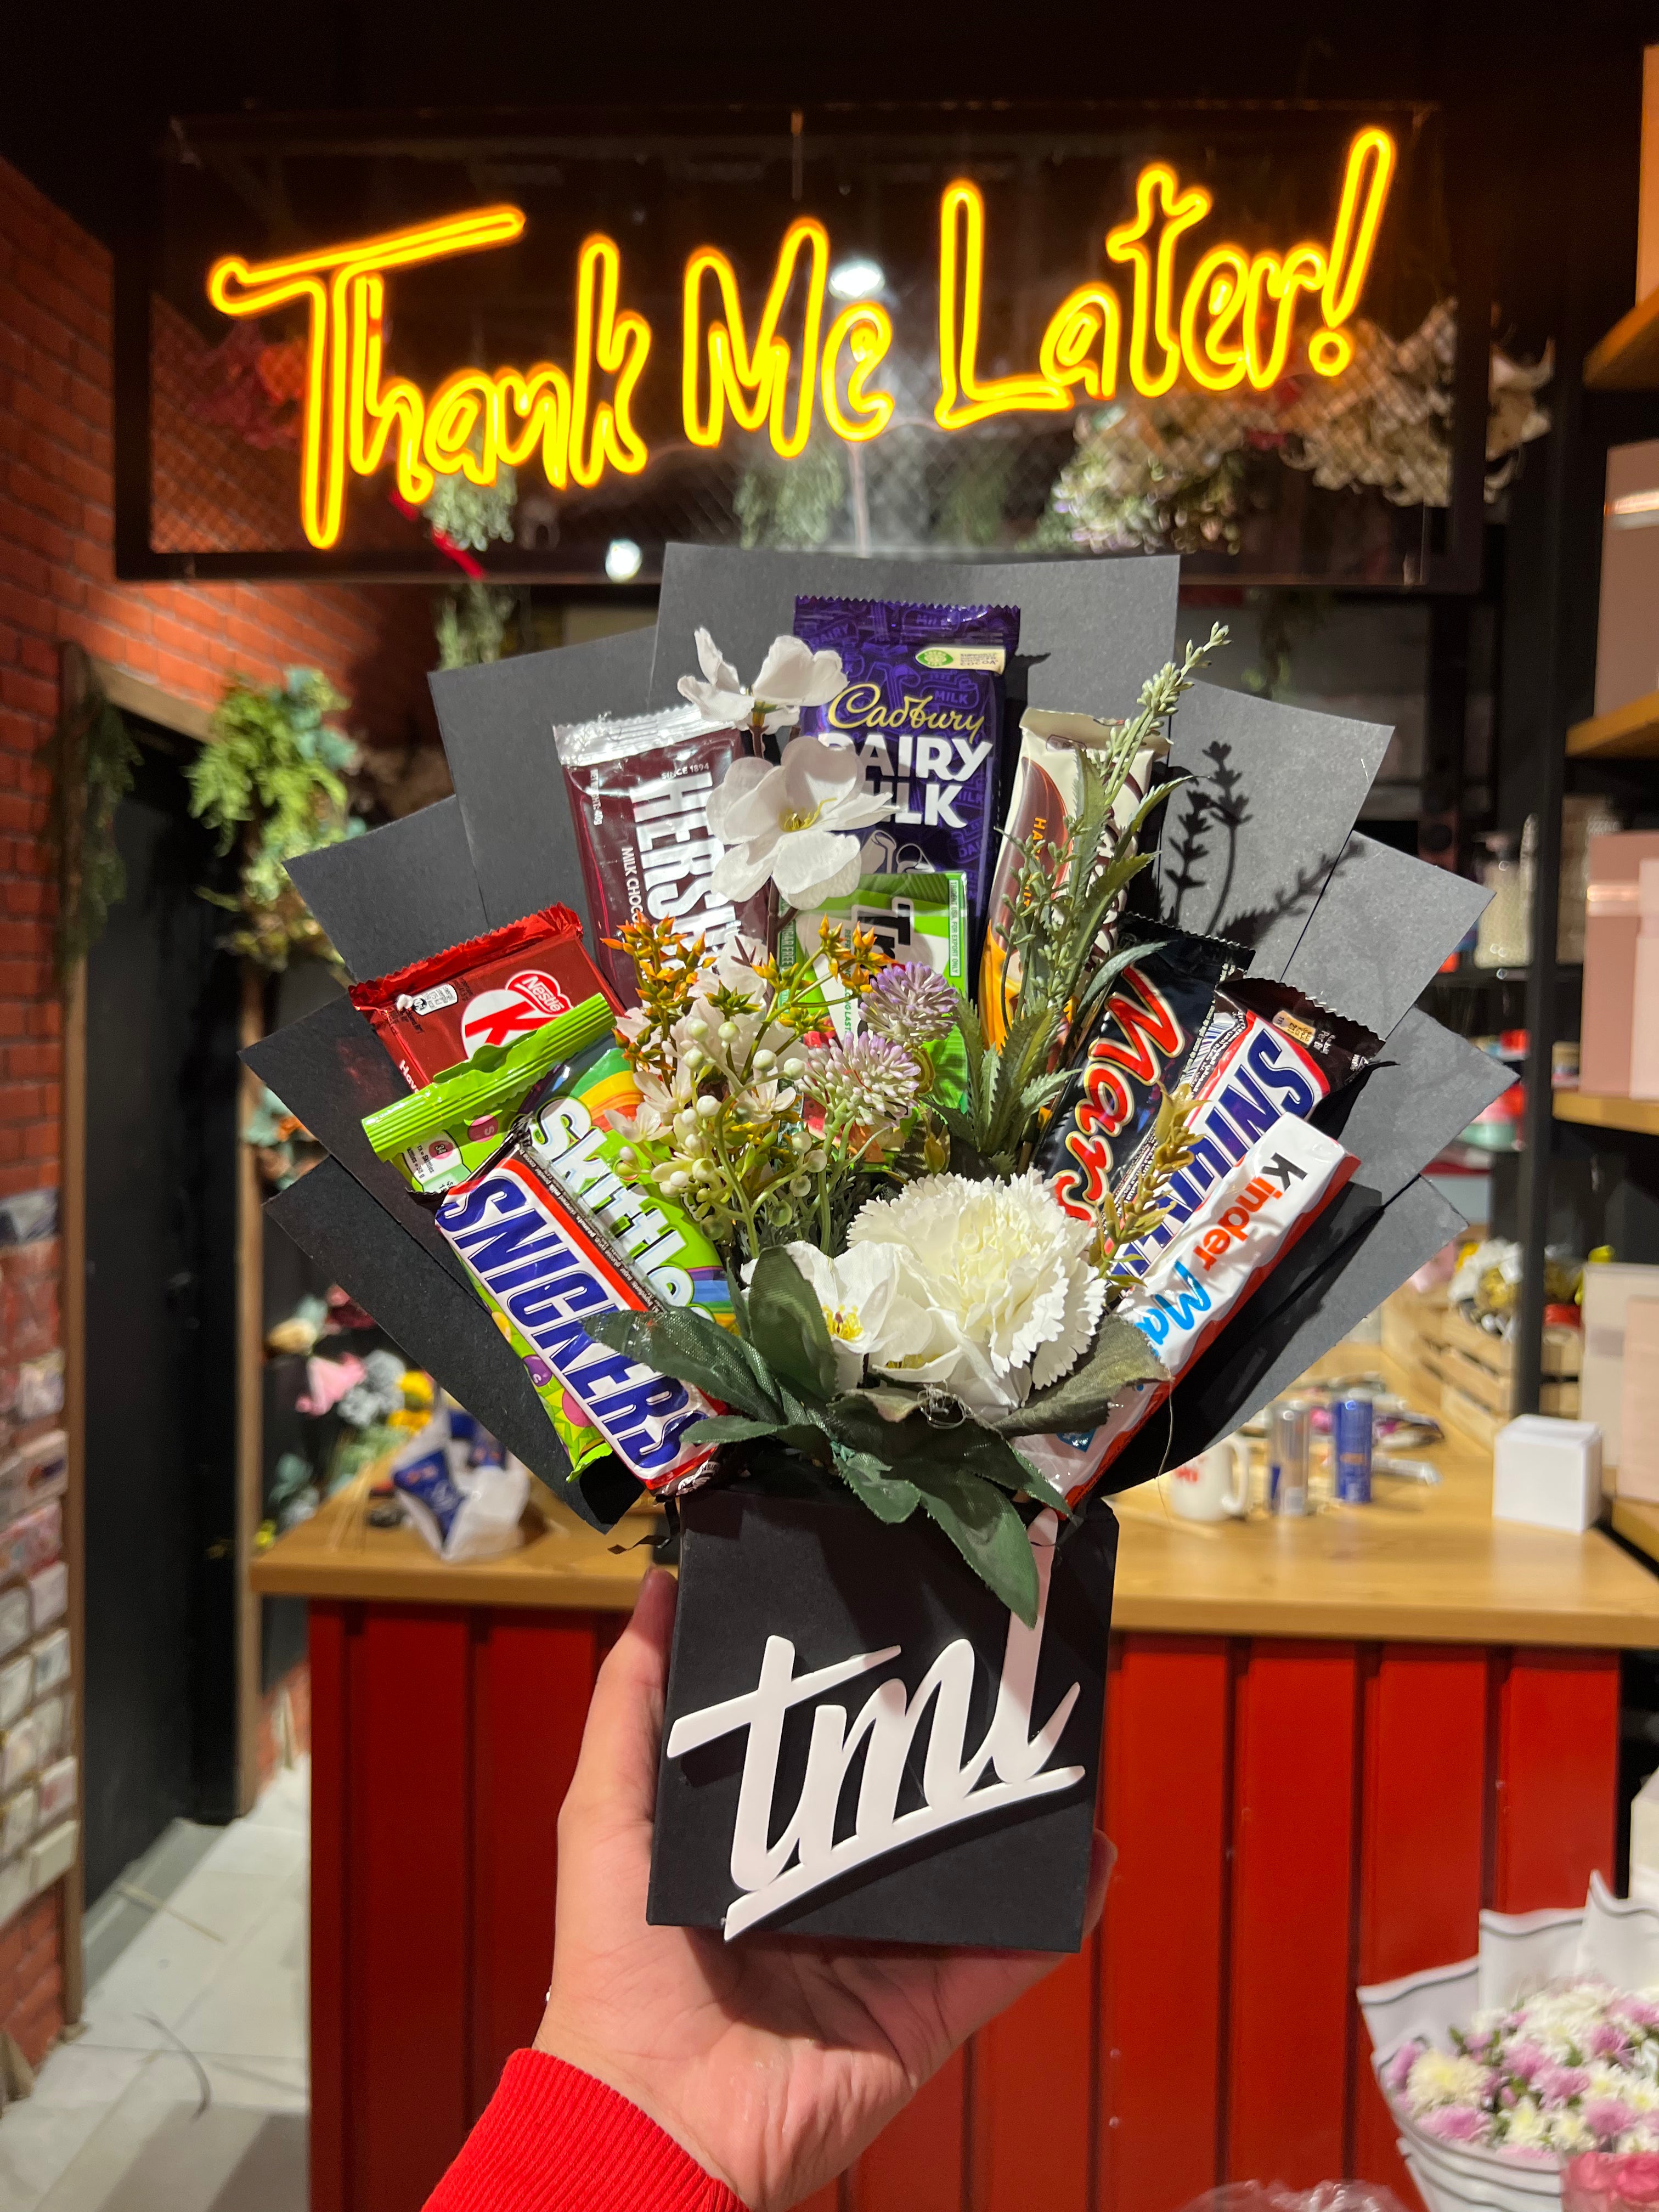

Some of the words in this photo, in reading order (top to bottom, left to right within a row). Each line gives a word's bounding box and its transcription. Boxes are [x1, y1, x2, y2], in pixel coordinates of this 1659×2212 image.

[208, 203, 652, 550] Thank
[682, 218, 895, 460] Me
[934, 125, 1398, 432] Later!
[827, 683, 985, 743] Cadbury
[689, 763, 710, 774] 1894
[818, 733, 993, 782] AIRY
[621, 846, 637, 876] MILK
[628, 771, 740, 972] HERSH
[522, 976, 565, 1012] Nestlé
[782, 947, 794, 964] FREE
[1316, 1029, 1330, 1043] Per
[1053, 964, 1184, 1227] Mars
[526, 1097, 715, 1324] Skittle
[548, 1183, 561, 1197] milk
[1192, 1149, 1308, 1271] Kinder
[437, 1175, 708, 1470] SNICKERS
[1133, 1261, 1212, 1358] Ma
[667, 1508, 1082, 1891] tml
